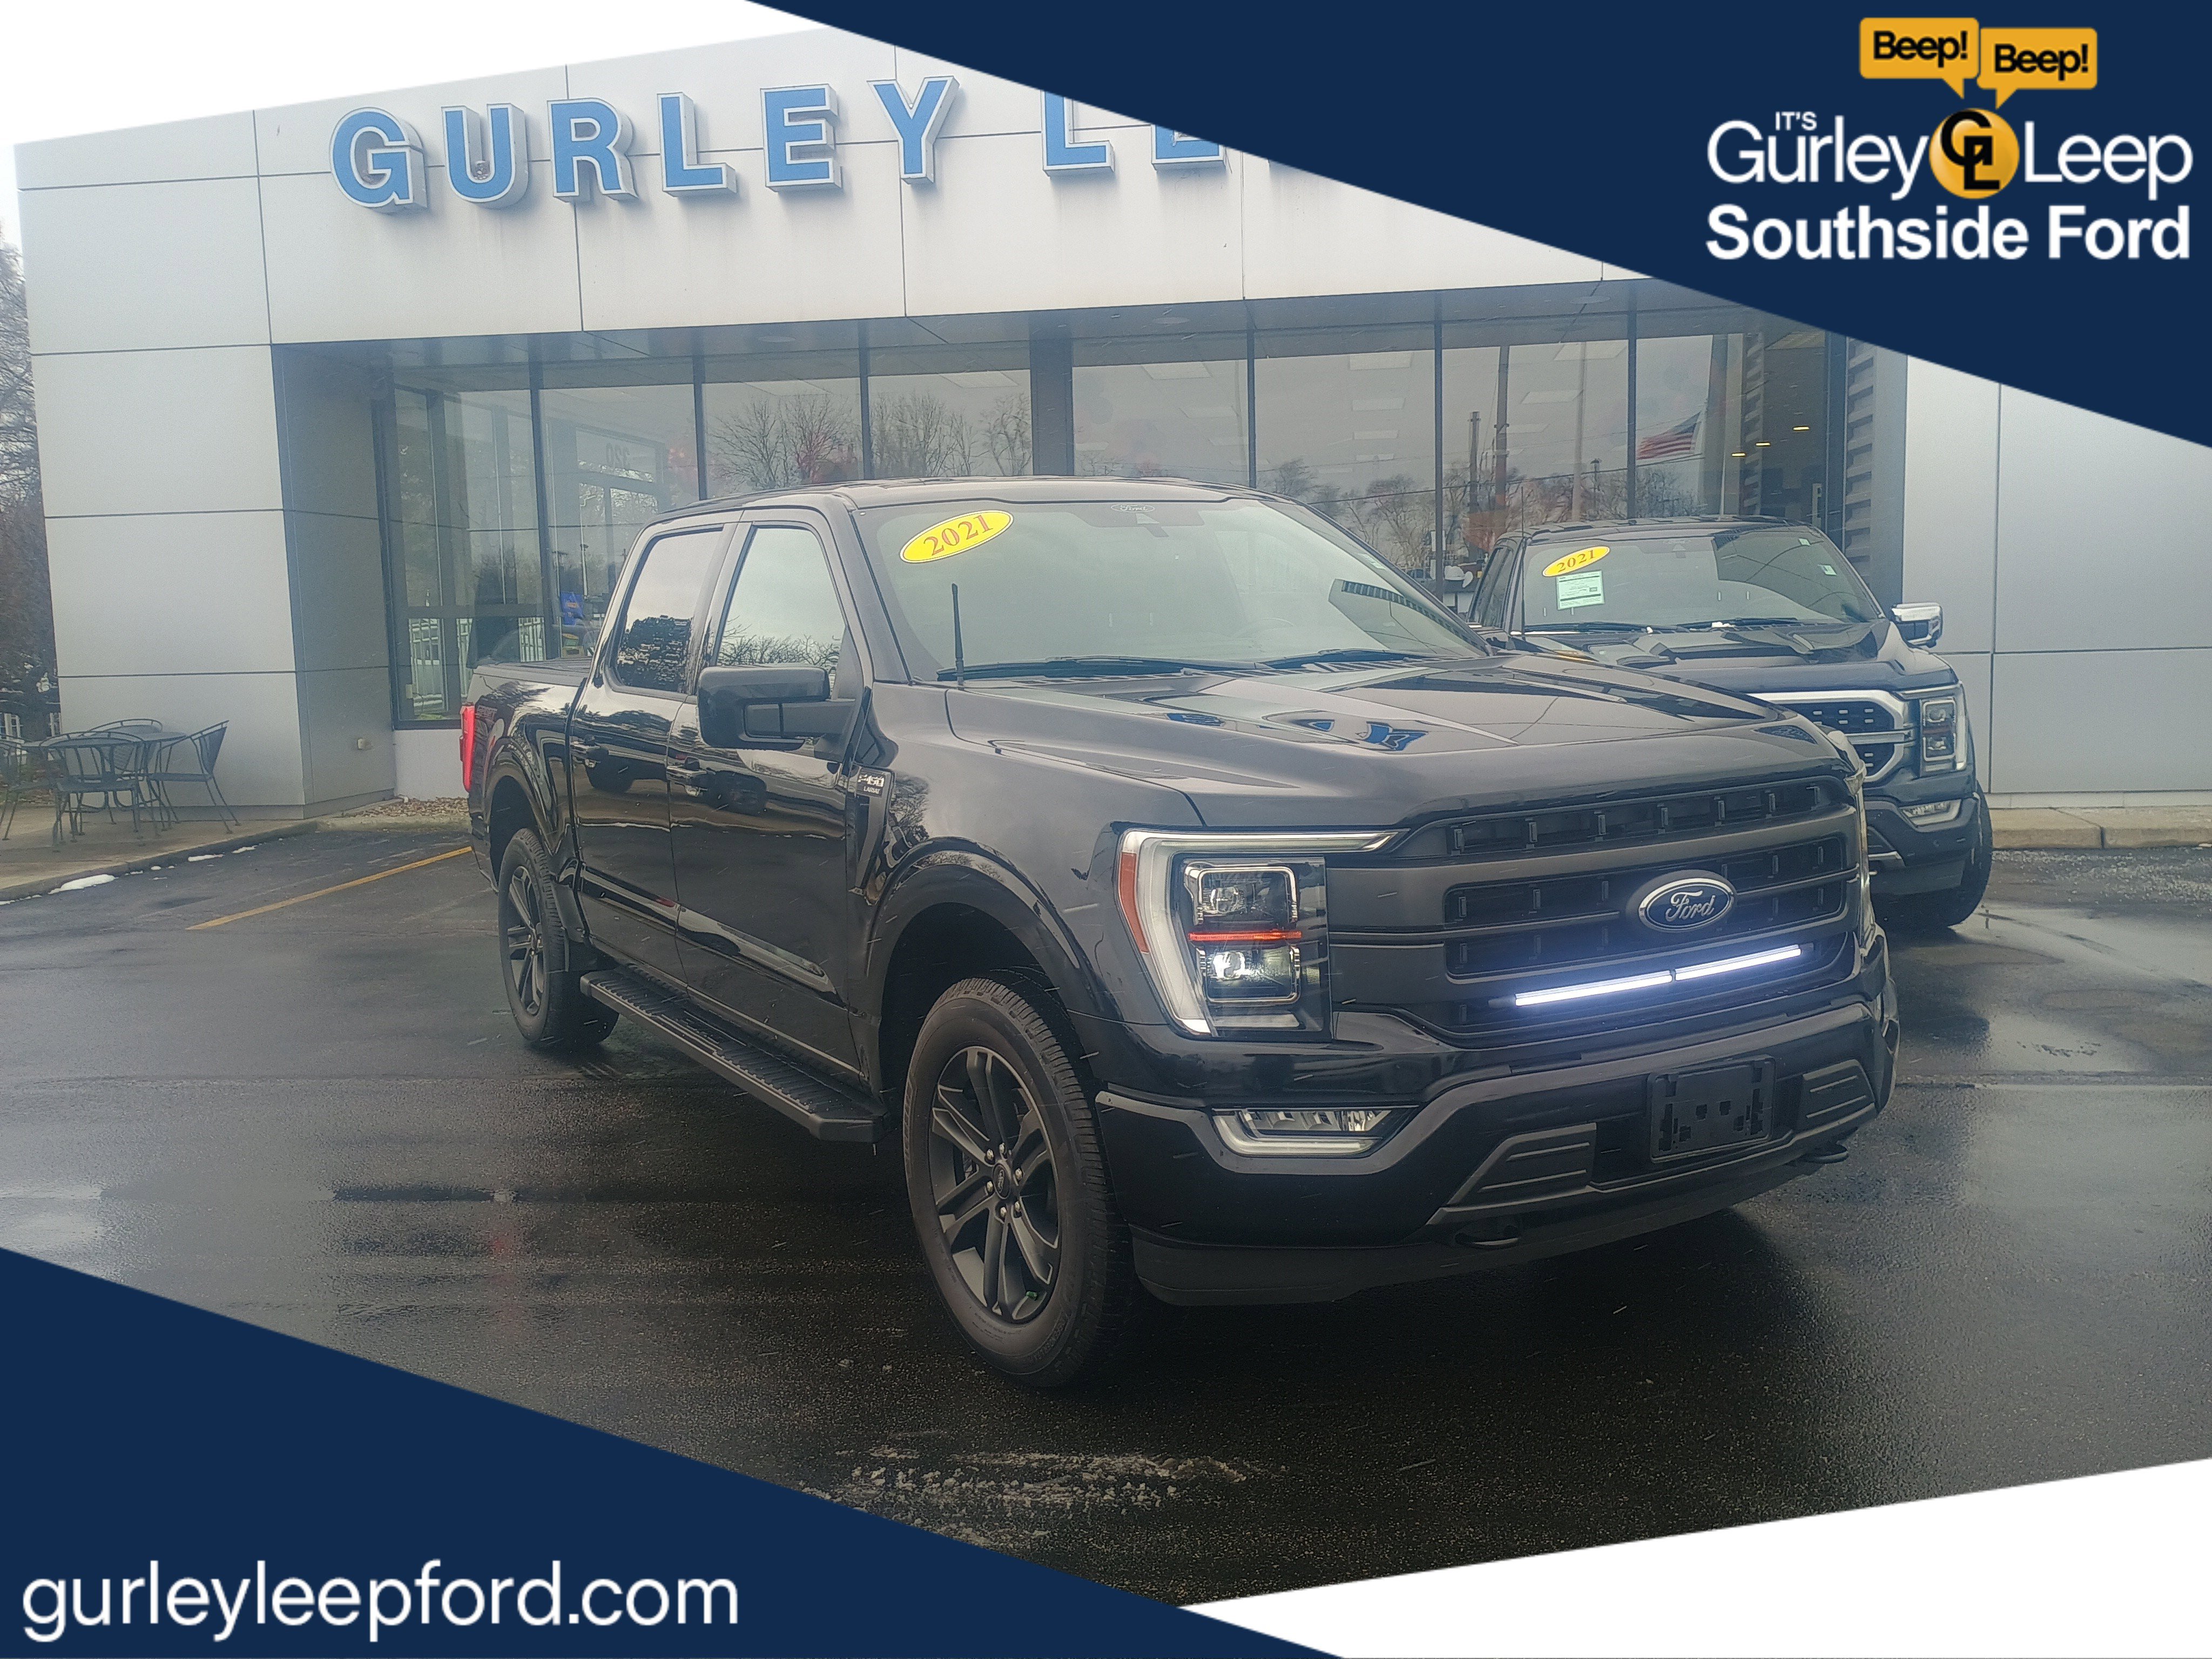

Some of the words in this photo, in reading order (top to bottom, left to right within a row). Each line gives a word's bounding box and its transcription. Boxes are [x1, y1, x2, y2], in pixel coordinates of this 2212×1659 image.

[329, 76, 960, 211] GURLEY
[924, 515, 994, 556] 2021
[1557, 550, 1595, 572] 2021
[1665, 890, 1716, 922] Ford
